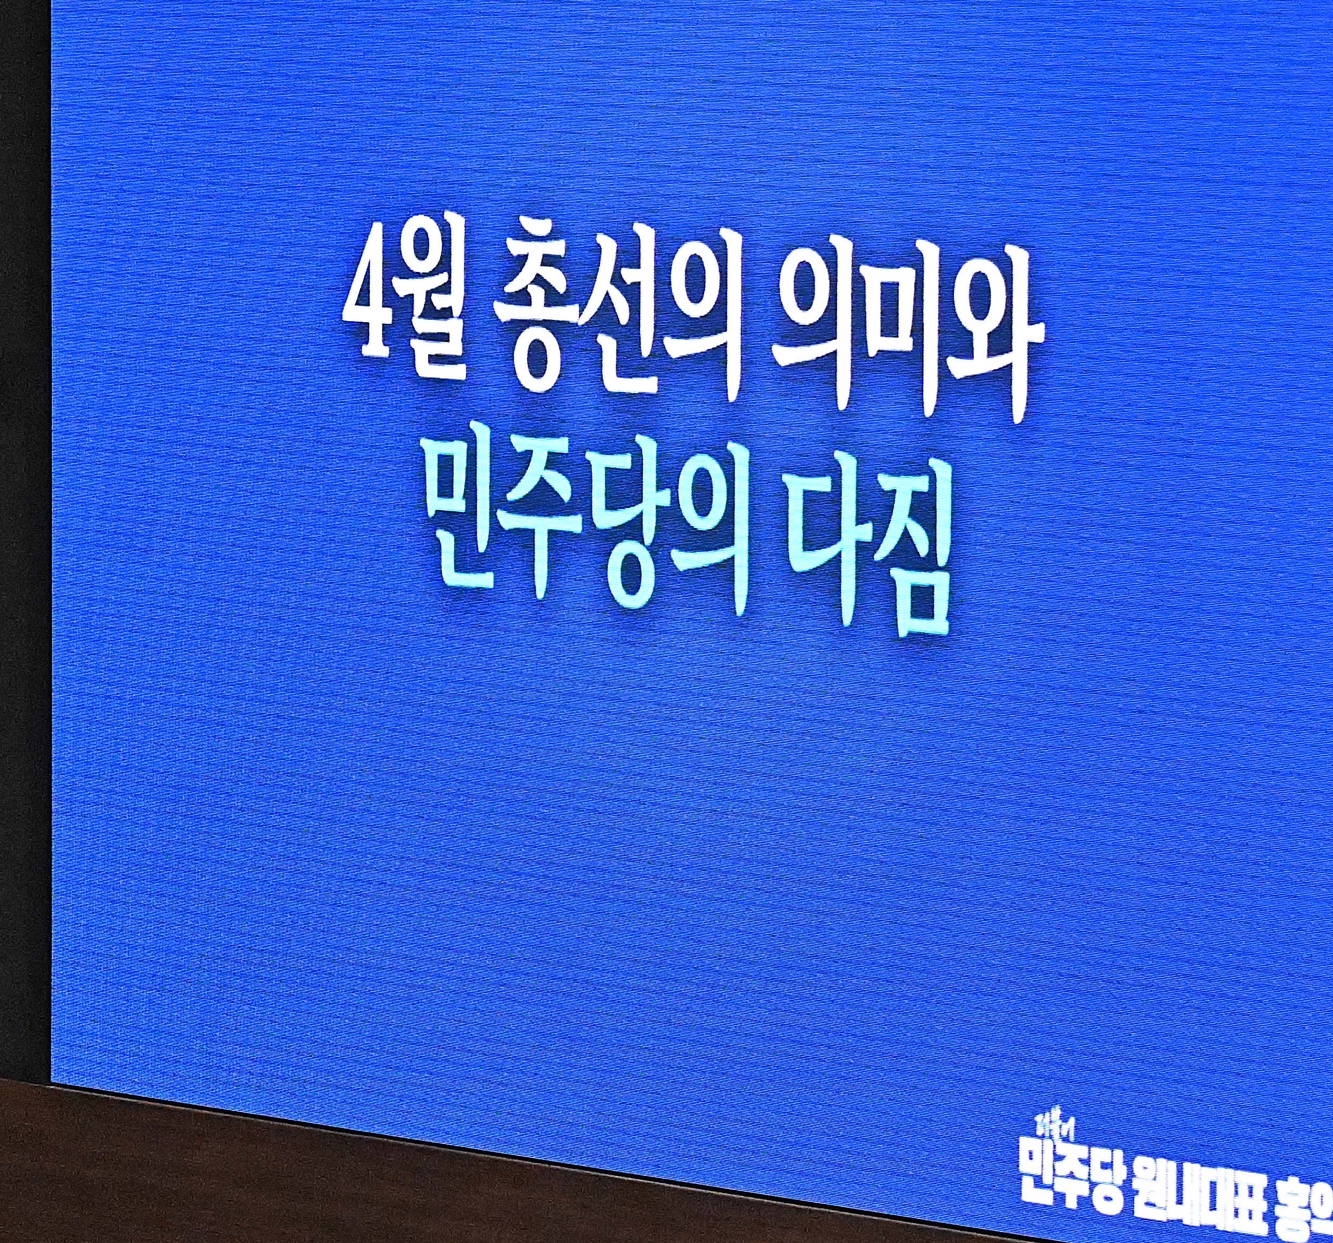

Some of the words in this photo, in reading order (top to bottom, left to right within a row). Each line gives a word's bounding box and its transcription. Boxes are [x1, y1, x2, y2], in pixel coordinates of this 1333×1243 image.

[341, 210, 467, 381] 4월
[492, 215, 743, 403] 총선의
[771, 234, 1046, 425] 의미와
[419, 419, 750, 617] 민주당의
[781, 449, 953, 638] 다짐
[1018, 1135, 1128, 1216] 민주당
